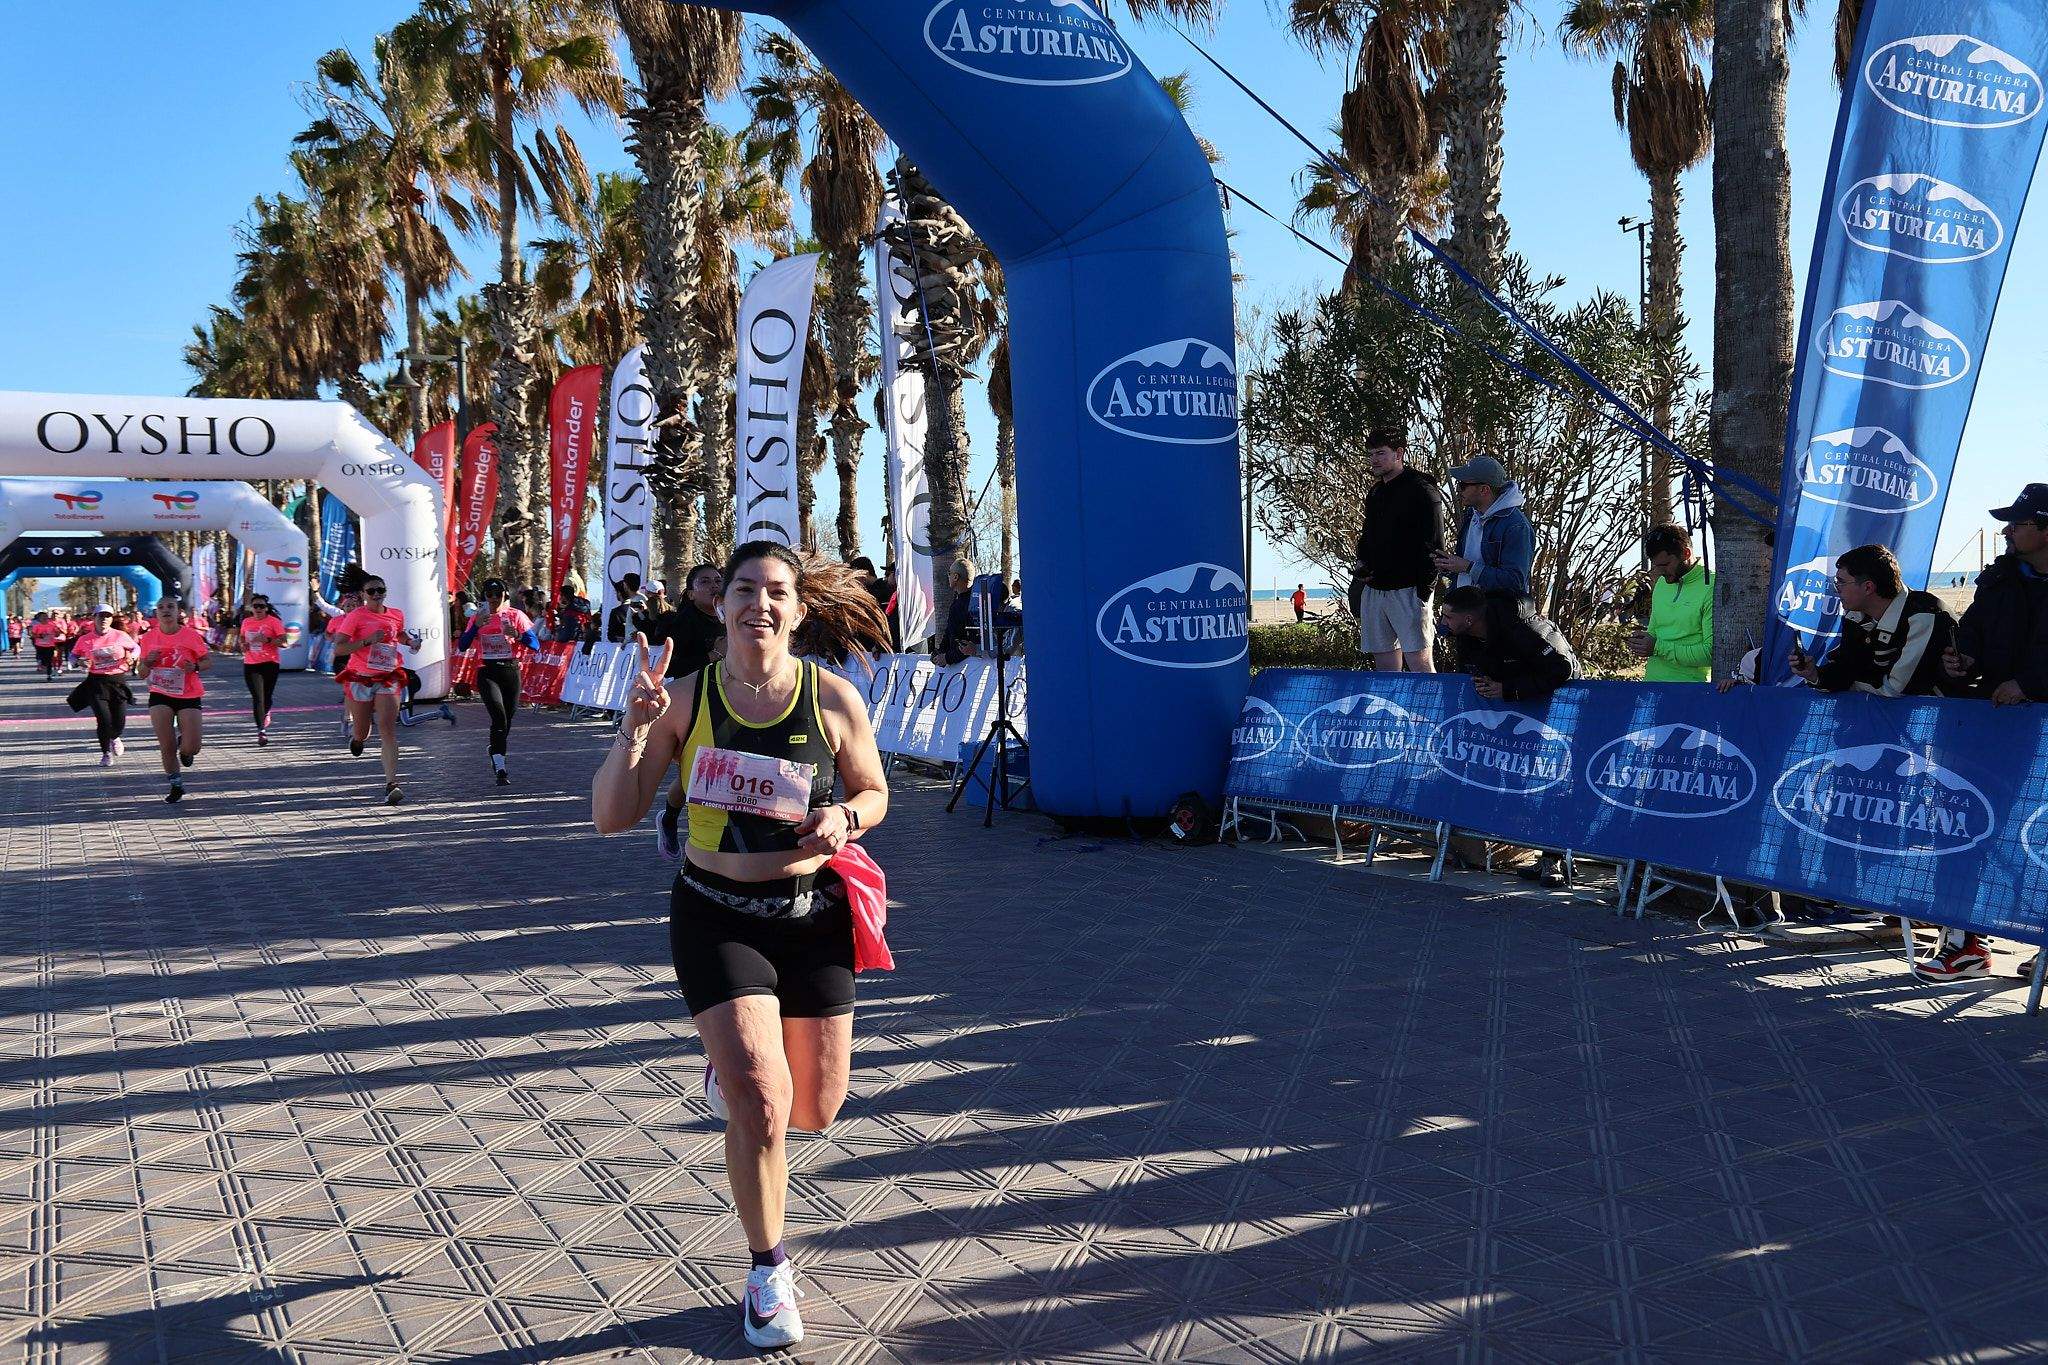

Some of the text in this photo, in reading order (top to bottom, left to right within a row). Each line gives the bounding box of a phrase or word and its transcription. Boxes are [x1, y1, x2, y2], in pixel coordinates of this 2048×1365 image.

[943, 8, 1126, 65] ASTURIANA
[983, 7, 1111, 37] CENTRAL LECHERA
[1875, 54, 2027, 115] ASTURIANA
[1907, 57, 2029, 88] CENTRAL LECHERA
[1847, 194, 1985, 250] ASTURIANA
[1869, 195, 1986, 225] CENTRAL LECHERA
[1826, 323, 1952, 377] ASTURIANA
[1845, 324, 1951, 352] CENTRAL LECHERA
[1138, 374, 1201, 385] CENTRAL
[37, 411, 276, 457] OYSHO
[561, 397, 583, 509] Santander
[1825, 452, 1919, 478] CENTRAL LECHERA
[342, 463, 405, 476] OYSHO
[466, 445, 492, 533] Santander
[27, 547, 131, 556] VOLVO
[1148, 599, 1211, 611] CENTRAL
[1113, 604, 1248, 643] ASTURIAN
[868, 666, 967, 713] OYSHO
[1302, 719, 1405, 750] ASTURIANA
[1324, 718, 1362, 727] CENTRAL
[1436, 728, 1558, 781] ASTURIANA
[1626, 752, 1740, 771] CENTRAL LECHERA
[729, 774, 775, 796] 016
[1594, 752, 1739, 801] ASTURIANA
[1826, 774, 1893, 792] CENTRAL
[736, 795, 758, 806] 9080
[1786, 771, 1973, 839] ASTURIANA
